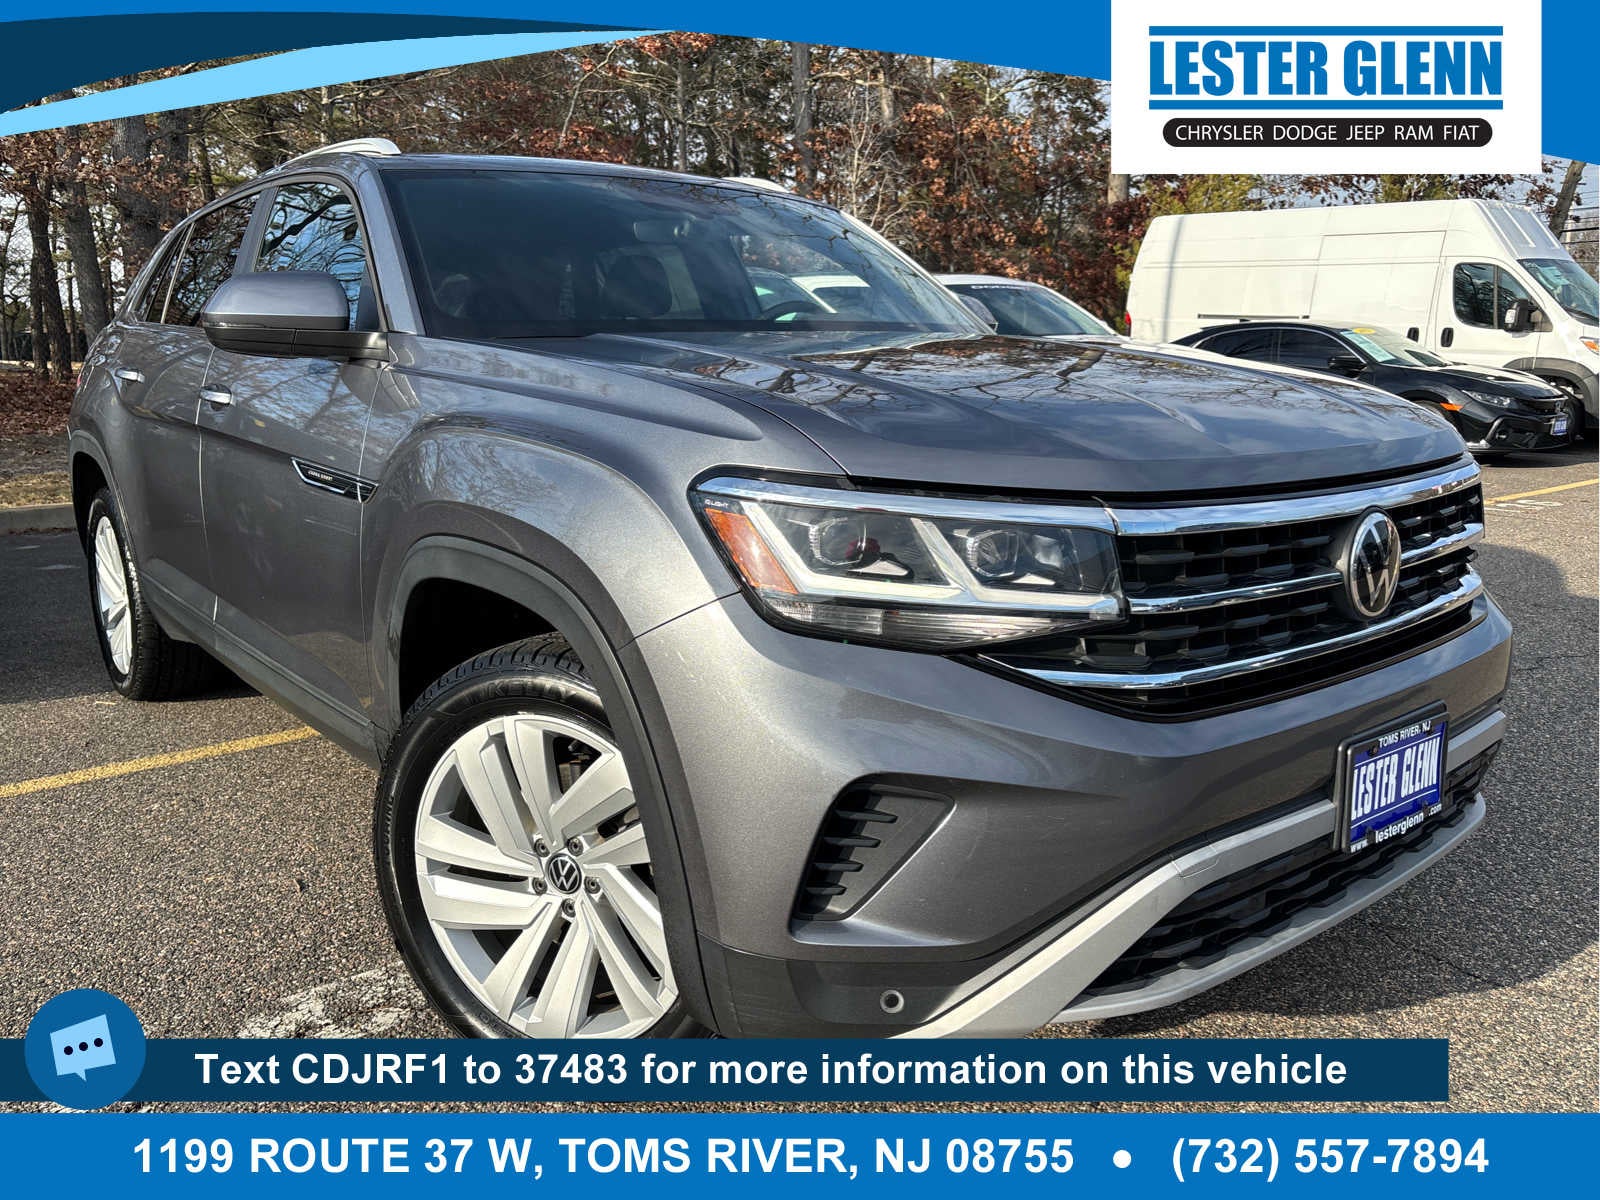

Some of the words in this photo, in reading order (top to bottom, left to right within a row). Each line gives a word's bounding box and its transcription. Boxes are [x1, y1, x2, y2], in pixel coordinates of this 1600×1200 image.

[1379, 732, 1399, 748] TOMS
[1422, 720, 1431, 732] NJ
[1351, 753, 1399, 821] LESTER
[1401, 736, 1441, 798] GLENN
[1375, 812, 1424, 844] lesterglenn
